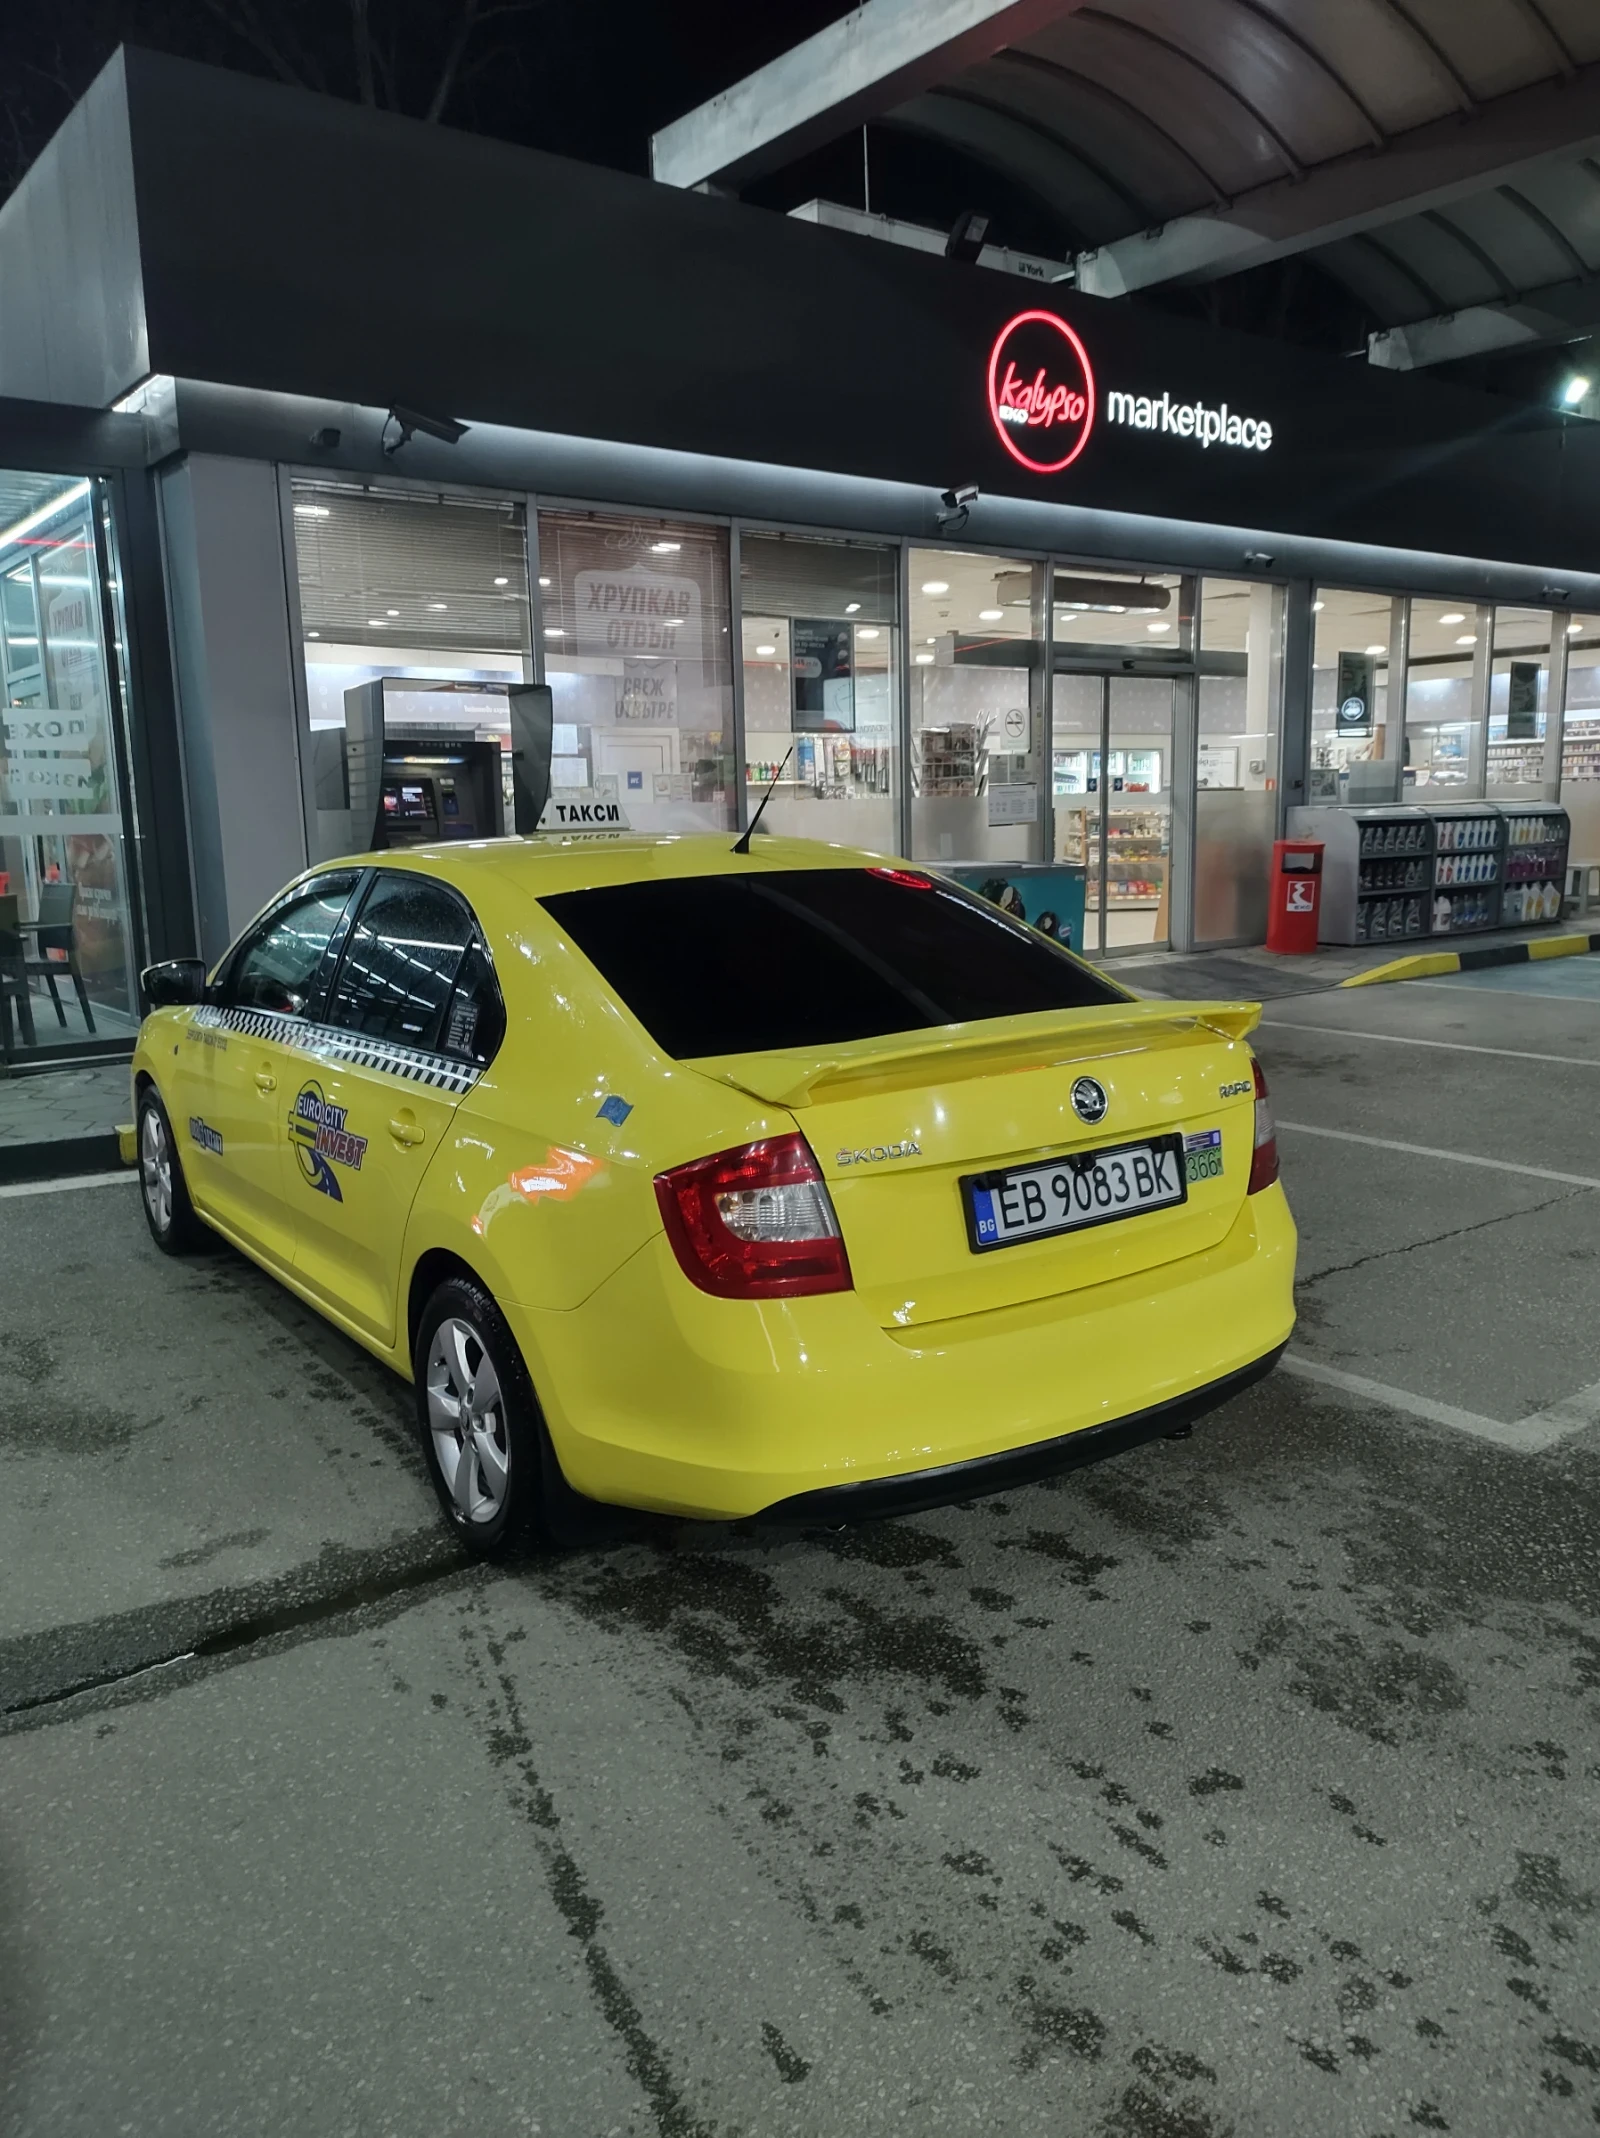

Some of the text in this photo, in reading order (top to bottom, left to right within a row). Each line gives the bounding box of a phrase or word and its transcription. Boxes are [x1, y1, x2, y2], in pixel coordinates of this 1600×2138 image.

[1000, 404, 1028, 424] EKO
[1107, 391, 1273, 451] marketplace
[588, 582, 690, 616] ХРУПКАВ
[606, 618, 676, 650] ОТВЪН
[623, 677, 664, 697] СВЕЖ
[615, 700, 675, 720] ОТВЪТРЕ
[556, 804, 620, 823] ТАКСИ
[315, 1123, 368, 1171] INVEST
[836, 1142, 922, 1167] ŠKODA
[1187, 1151, 1218, 1181] 366
[1000, 1150, 1174, 1229] EB 9083 BK
[979, 1219, 995, 1234] BG
